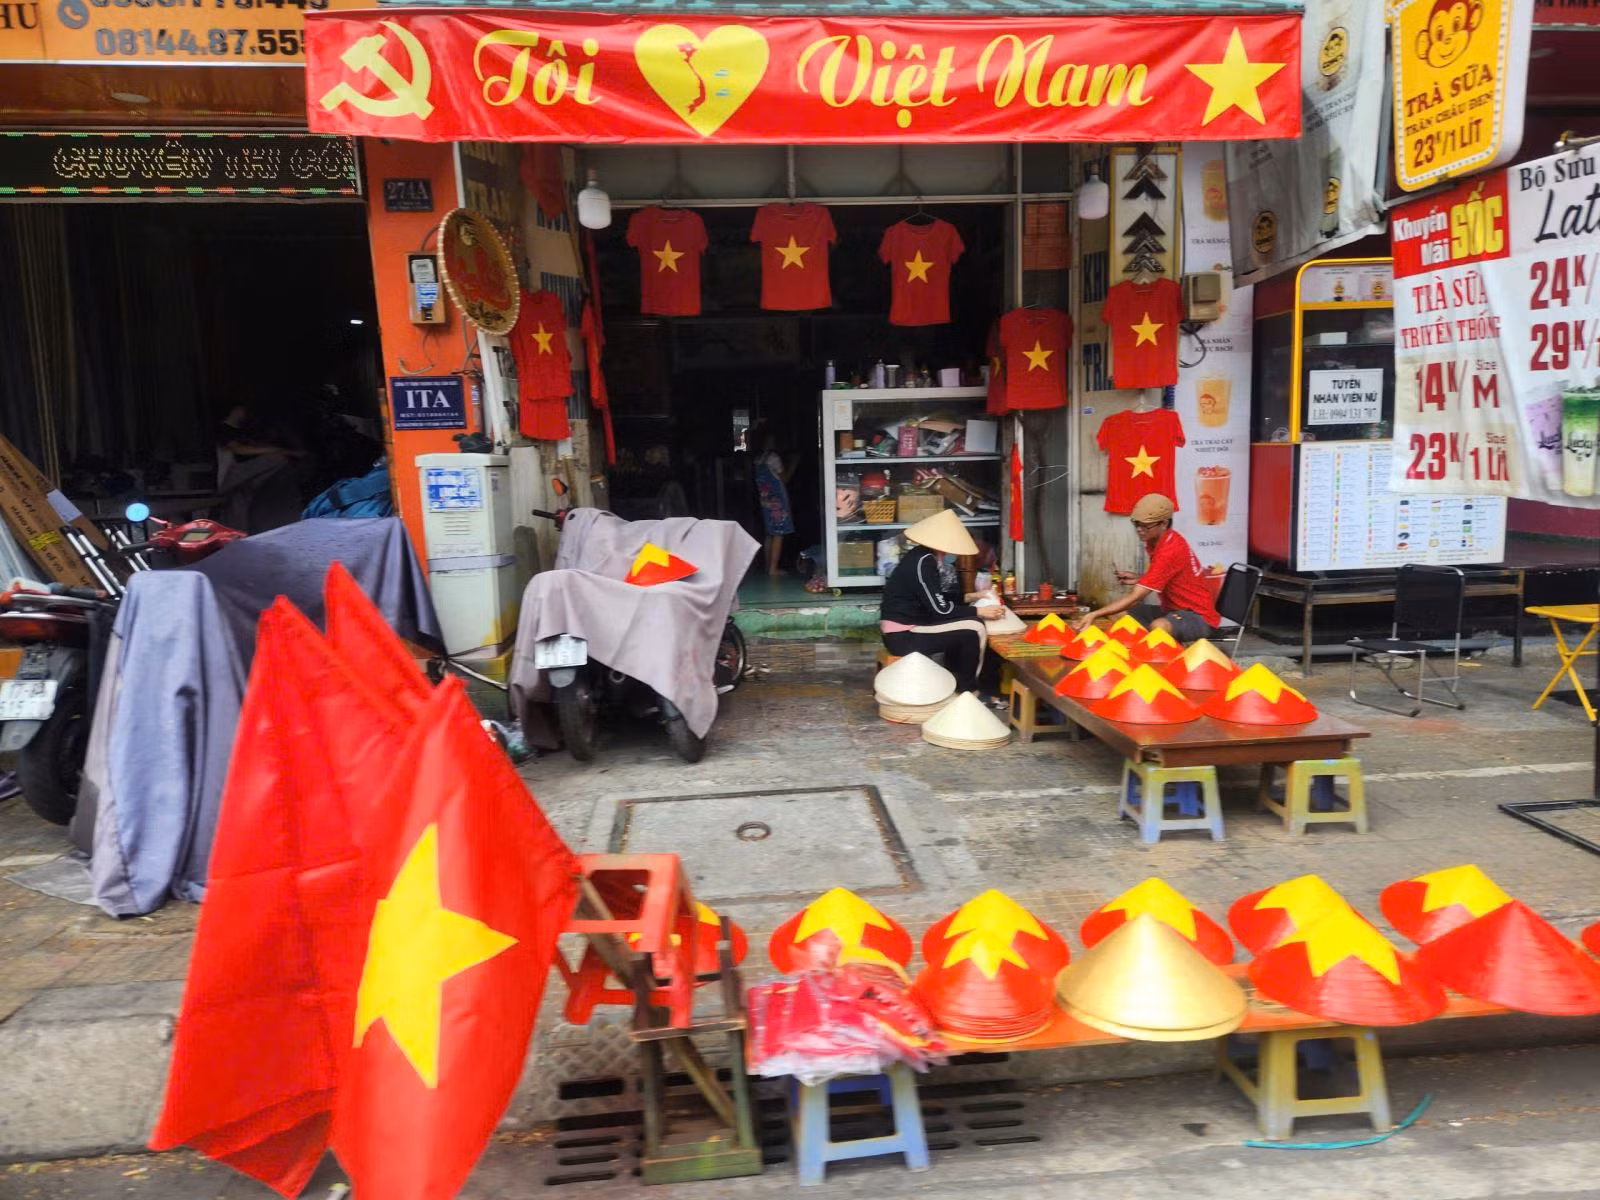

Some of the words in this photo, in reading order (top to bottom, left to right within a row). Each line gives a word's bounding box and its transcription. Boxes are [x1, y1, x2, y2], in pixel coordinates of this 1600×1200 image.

[94, 28, 305, 55] 08144.87.55
[473, 30, 602, 106] Tôi
[797, 33, 956, 128] Việt
[976, 33, 1153, 107] Nam
[1406, 82, 1444, 118] TRÀ
[1450, 64, 1493, 98] SỮA
[1519, 165, 1545, 192] Bộ
[1554, 157, 1596, 183] Sưu
[1451, 182, 1504, 260] SỐC
[1476, 359, 1497, 371] Size
[406, 389, 451, 408] ITA
